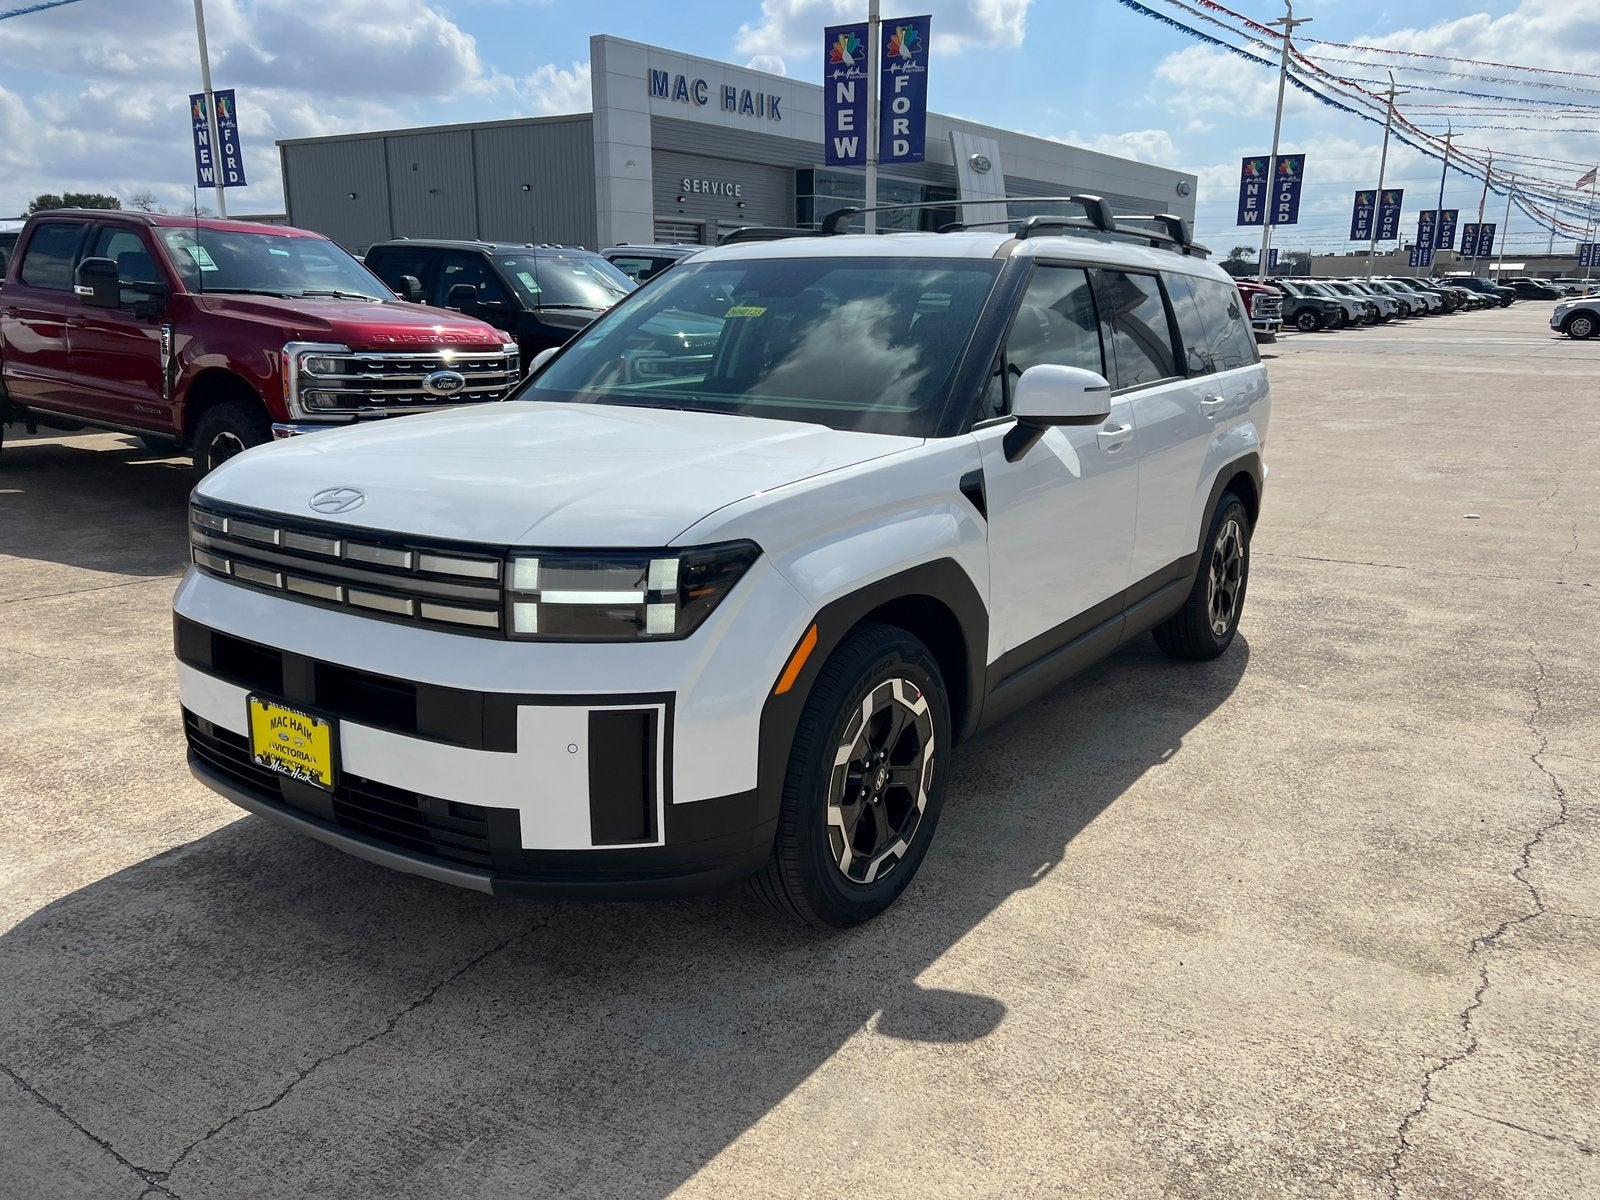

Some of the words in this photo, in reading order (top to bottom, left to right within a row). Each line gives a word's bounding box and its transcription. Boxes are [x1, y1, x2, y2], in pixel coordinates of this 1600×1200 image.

[651, 69, 708, 106] MAC
[723, 85, 782, 121] HAIK
[833, 81, 859, 159] NEW
[892, 75, 911, 157] FORD
[197, 130, 213, 183] NEW
[223, 129, 239, 183] FORD
[683, 178, 742, 197] SERVICE
[1244, 183, 1259, 222] NEW
[1278, 182, 1292, 222] FORD
[1355, 210, 1368, 239] NEW
[1382, 209, 1393, 239] FORD
[1420, 225, 1430, 248] NEW
[1441, 225, 1450, 248] FORD
[1463, 236, 1472, 255] NEW
[1481, 236, 1489, 255] FORD
[372, 333, 443, 343] SUPER
[445, 334, 488, 343] DUTY
[436, 378, 458, 389] Ford
[270, 716, 288, 731] MAC
[289, 717, 313, 744] HAIK
[269, 759, 291, 777] Mac
